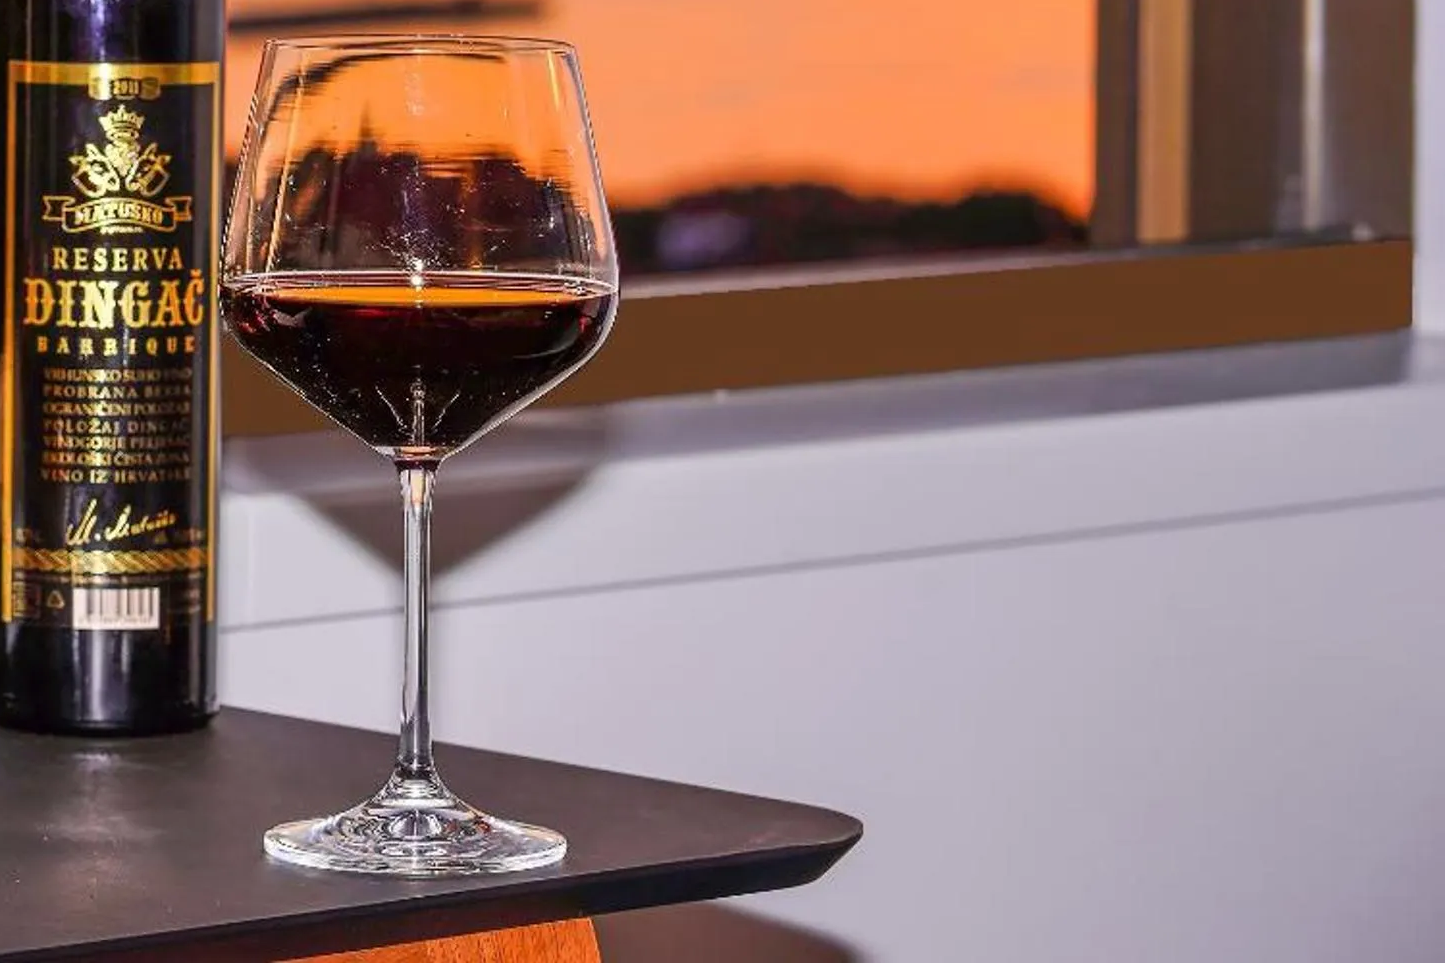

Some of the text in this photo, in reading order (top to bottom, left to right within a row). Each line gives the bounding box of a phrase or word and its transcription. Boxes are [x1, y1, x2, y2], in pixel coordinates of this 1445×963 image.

[52, 248, 183, 271] RESERVA
[23, 269, 204, 329] DINGAČ
[37, 336, 196, 356] BARRIQUE
[43, 384, 138, 398] PROBRANA
[43, 417, 121, 434] POLOŽAJ
[40, 469, 84, 483] VINO
[89, 468, 108, 484] IZ
